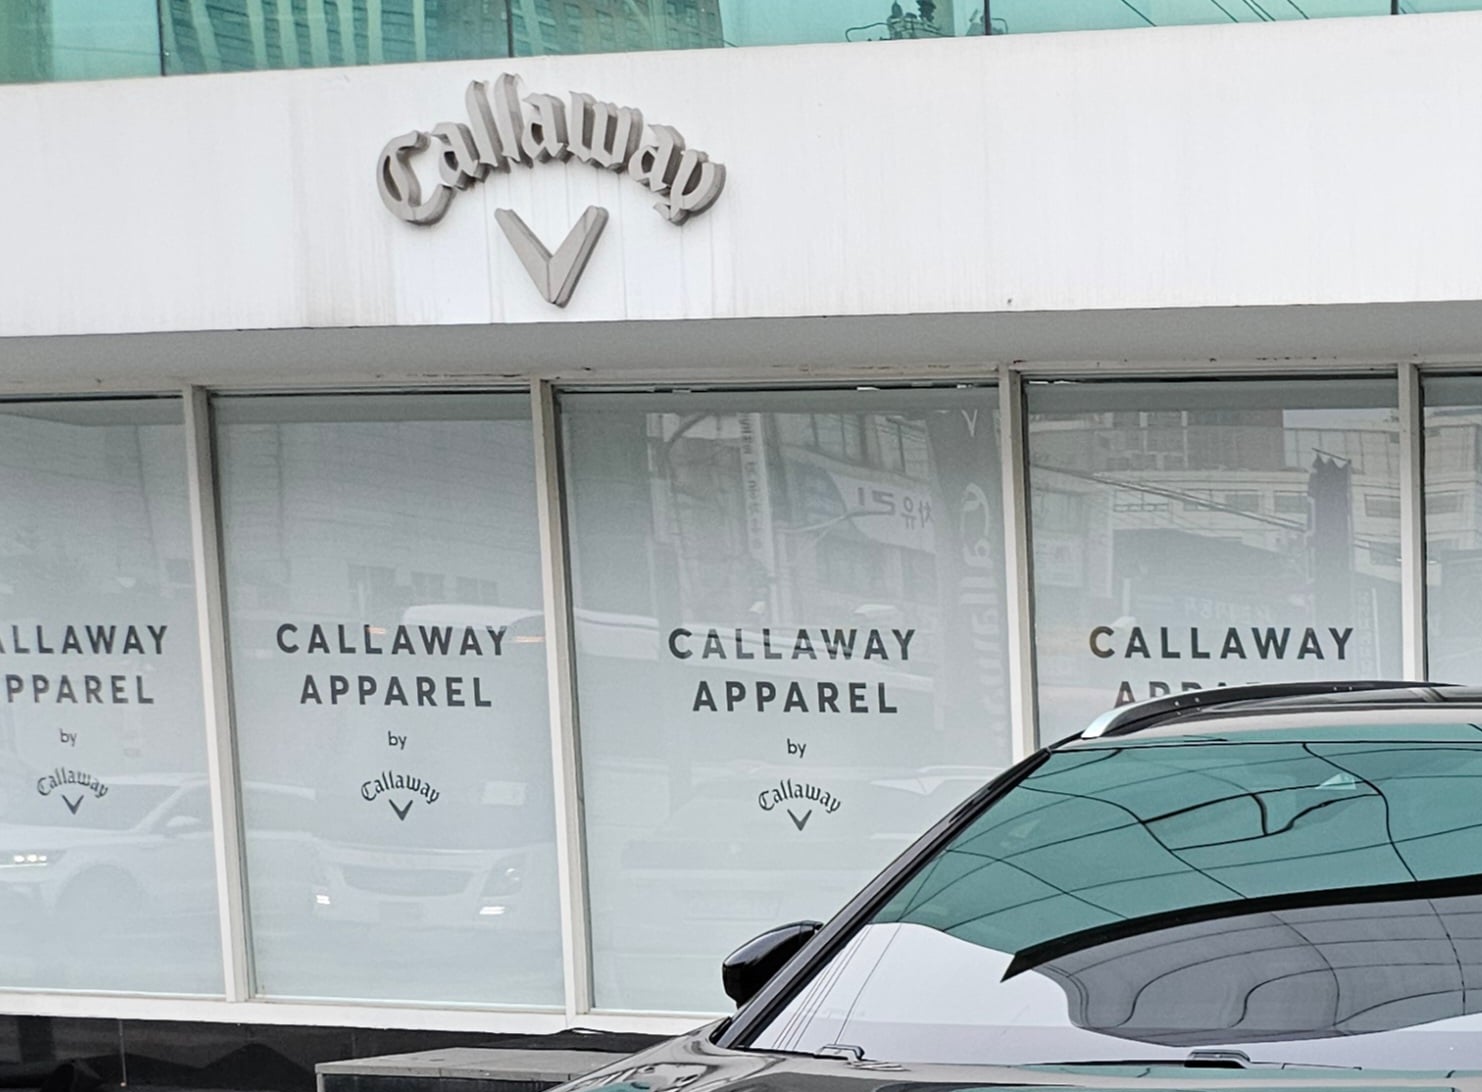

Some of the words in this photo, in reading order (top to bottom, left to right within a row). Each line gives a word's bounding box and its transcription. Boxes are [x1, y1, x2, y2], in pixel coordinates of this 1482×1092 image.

[376, 73, 727, 227] Callaway
[0, 625, 168, 655] LLAWAY
[276, 623, 508, 657] CALLAWAY
[668, 627, 917, 661] CALLAWAY
[1089, 626, 1354, 661] CALLAWAY
[299, 674, 493, 708] APPAREL
[692, 680, 899, 714] APPAREL
[59, 728, 77, 746] by
[387, 730, 408, 750] by
[786, 737, 807, 758] by
[36, 766, 109, 798] Callaway
[360, 769, 441, 804] Callaway
[757, 778, 842, 814] Callaway
